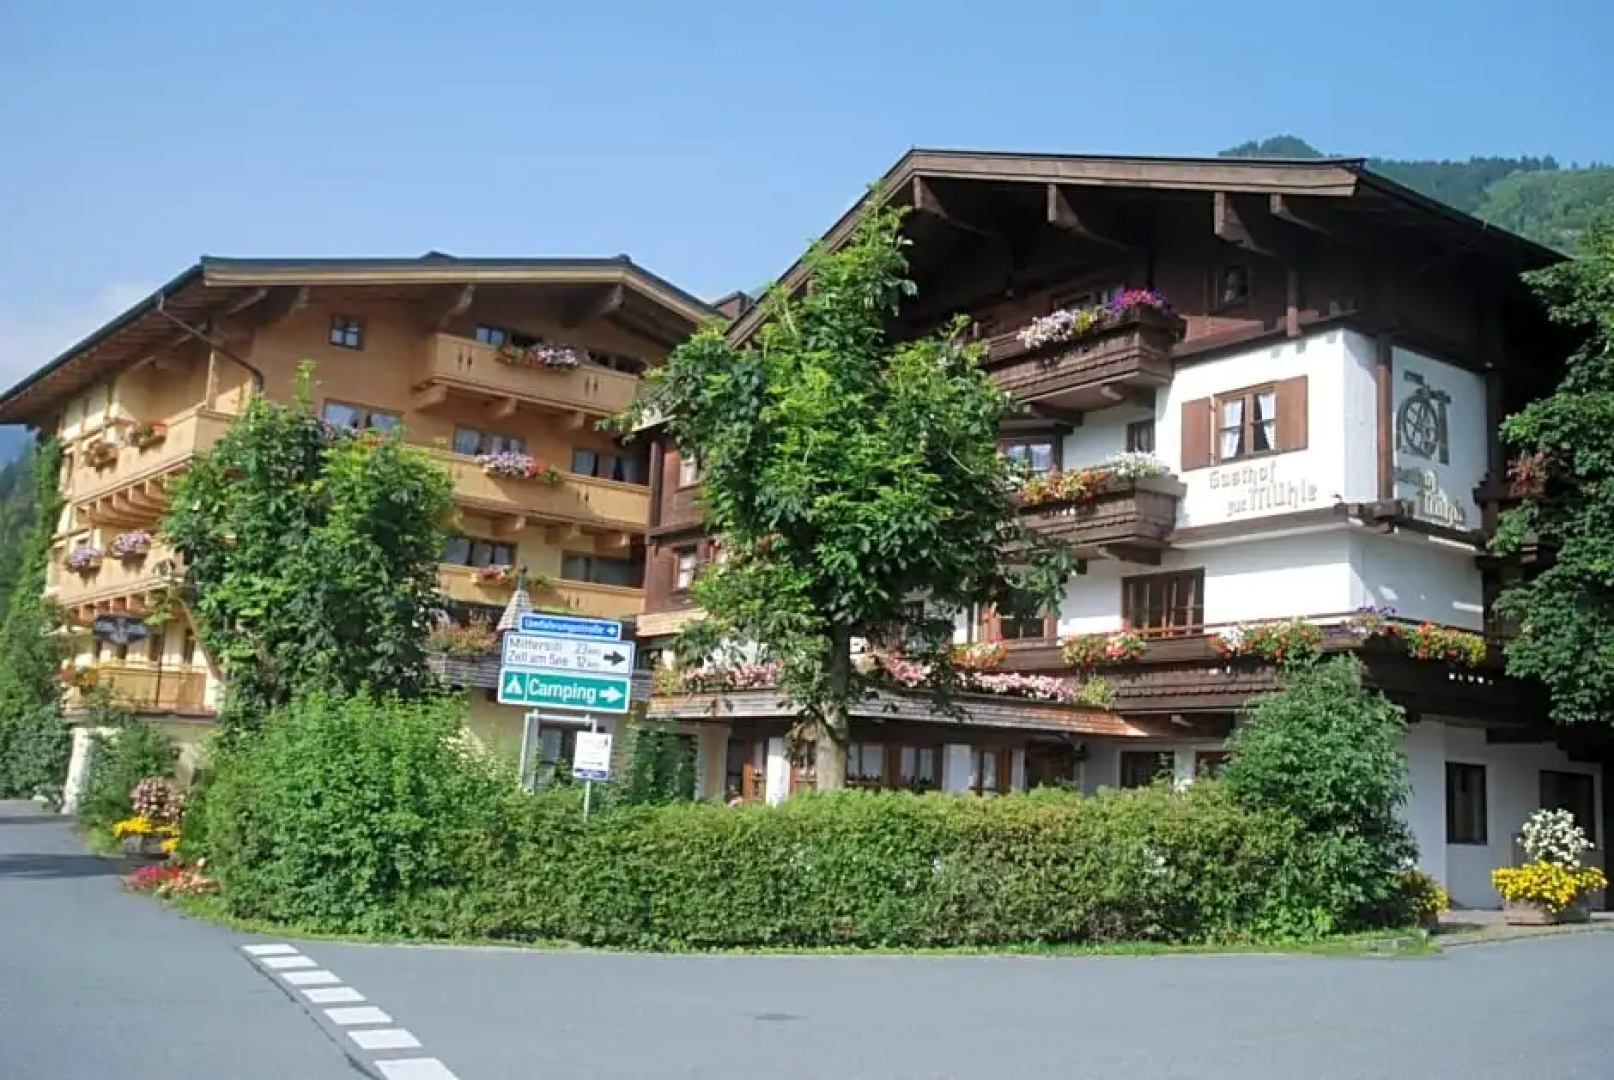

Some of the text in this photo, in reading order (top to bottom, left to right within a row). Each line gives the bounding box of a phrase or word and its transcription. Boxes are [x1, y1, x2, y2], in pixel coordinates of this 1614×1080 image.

[1209, 460, 1276, 490] Gasthof
[507, 650, 527, 662] Zell
[548, 653, 569, 667] See
[529, 677, 597, 705] Camping
